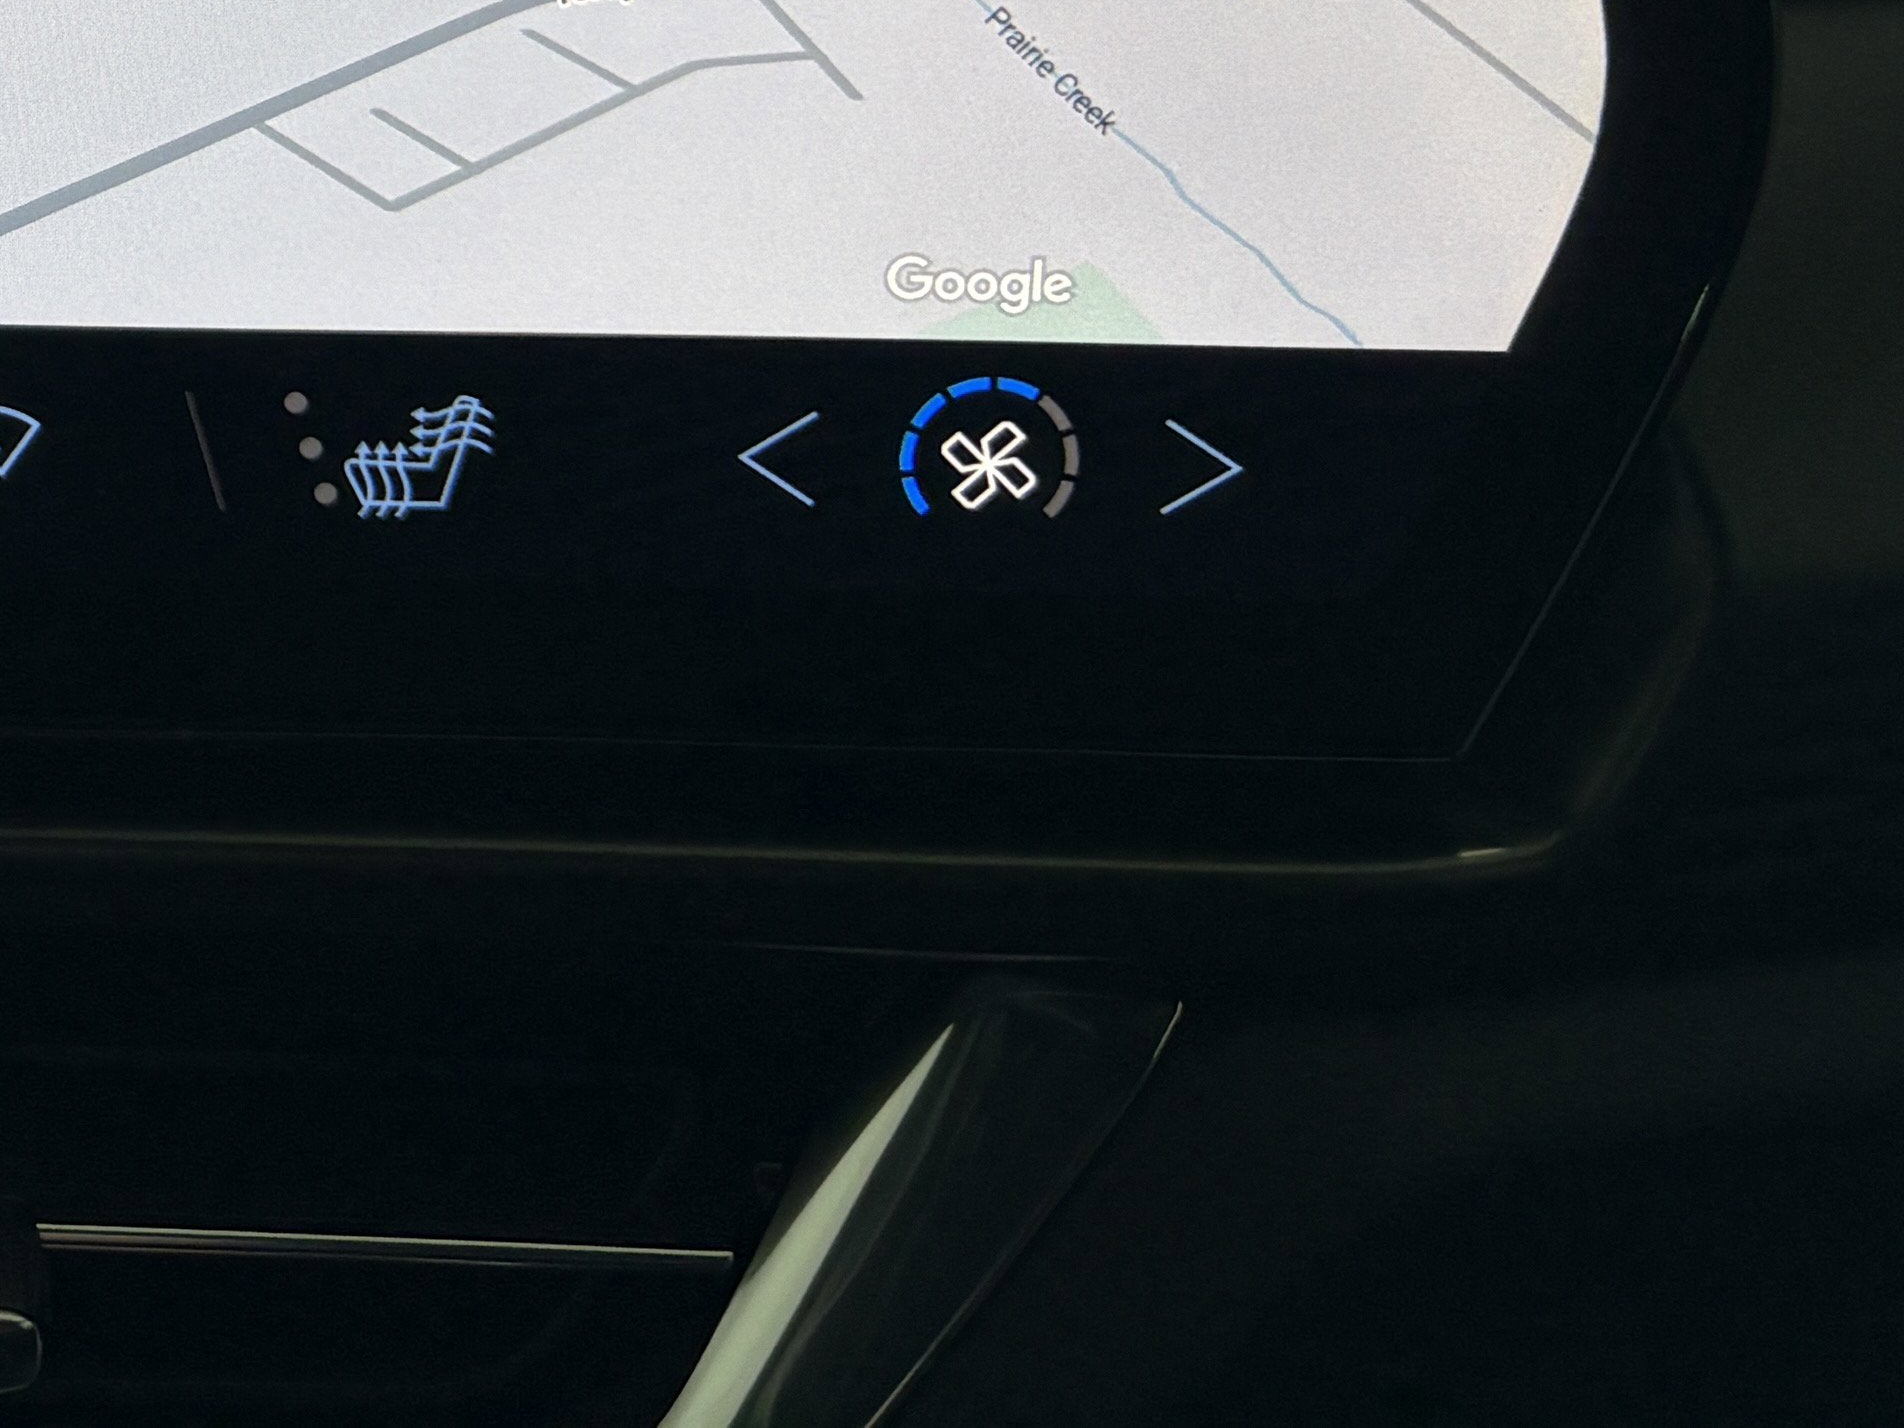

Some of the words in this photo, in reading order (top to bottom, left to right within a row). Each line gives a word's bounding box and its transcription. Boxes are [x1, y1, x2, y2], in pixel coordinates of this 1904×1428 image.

[986, 6, 1054, 78] Prairie
[1054, 73, 1114, 135] Creek
[886, 254, 1073, 315] Google
